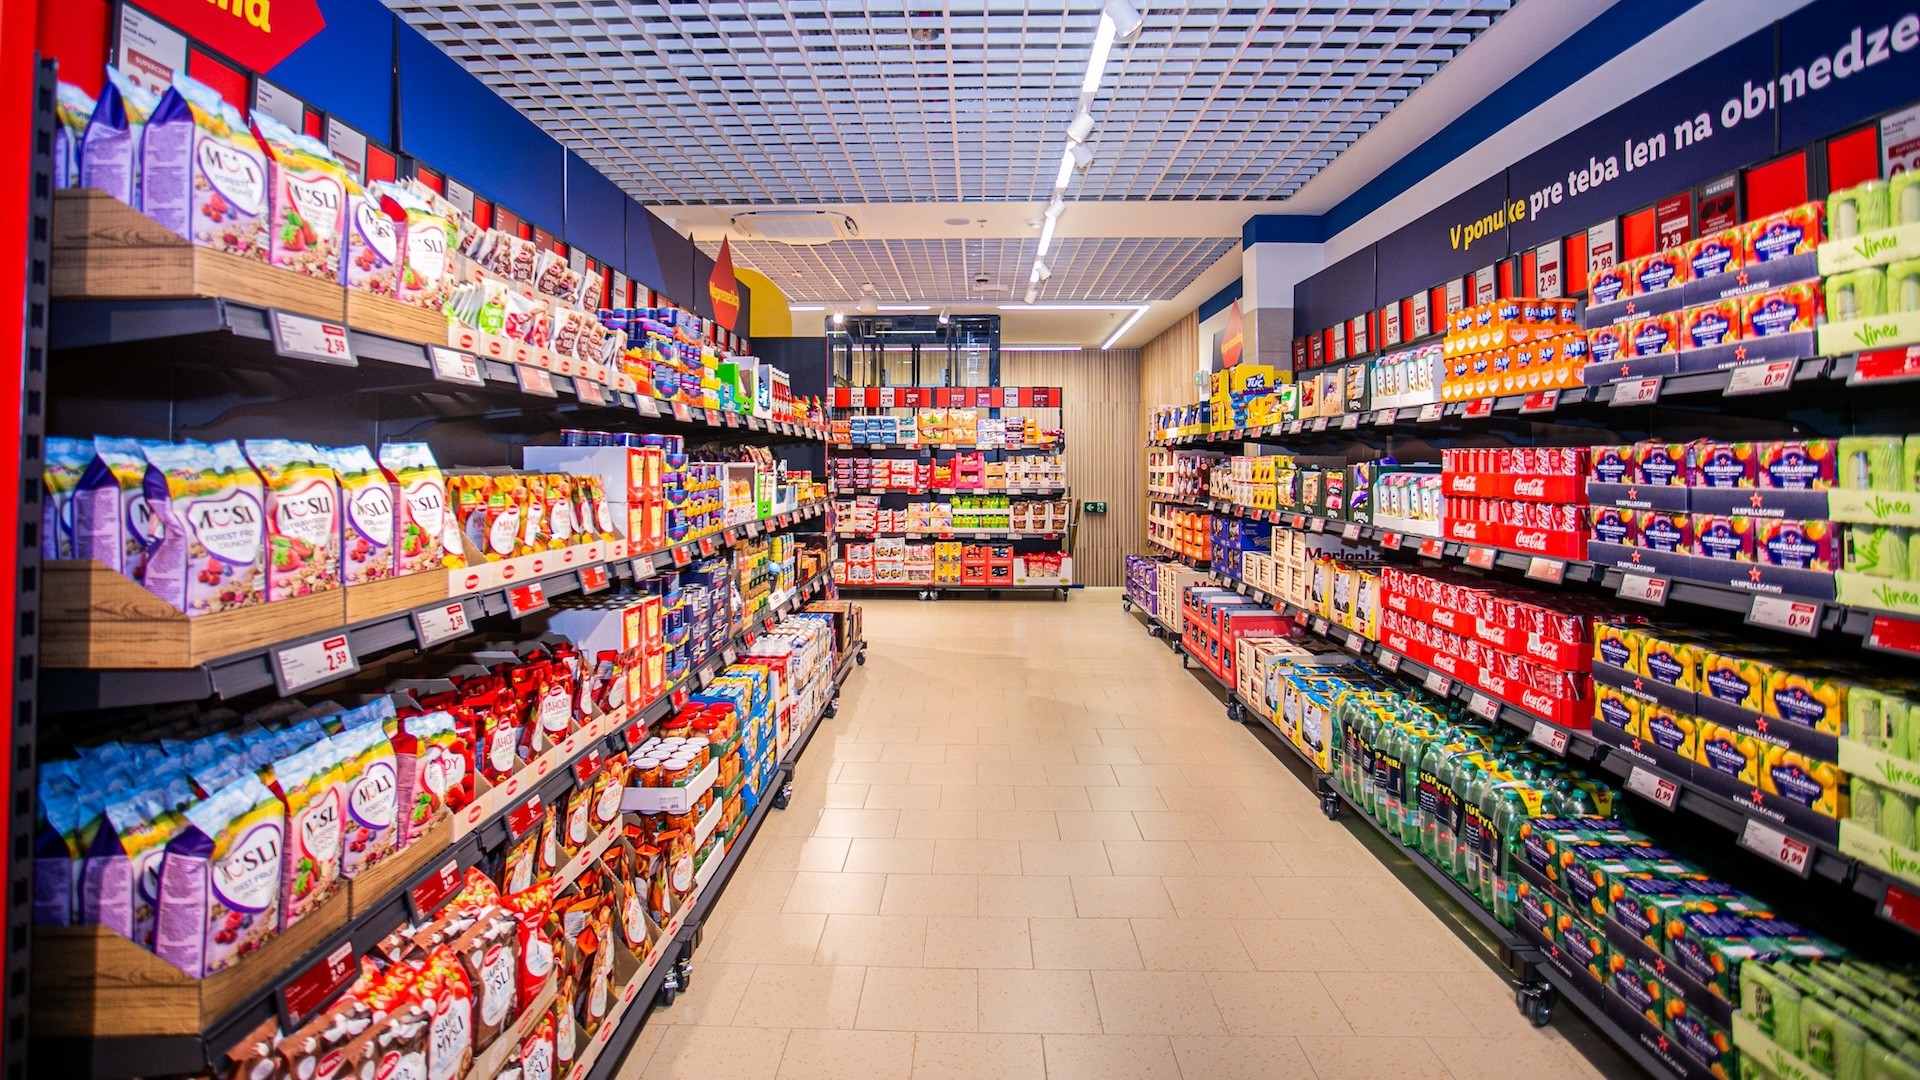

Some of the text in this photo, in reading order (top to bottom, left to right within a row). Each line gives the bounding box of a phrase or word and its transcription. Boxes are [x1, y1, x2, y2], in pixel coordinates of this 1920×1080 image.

[1450, 223, 1461, 250] V
[1463, 199, 1526, 251] ponuke
[1530, 183, 1563, 221] pre
[1568, 154, 1619, 198] teba
[1624, 131, 1666, 173] len
[1674, 112, 1713, 151] na
[1706, 180, 1735, 196] PARKSIDE
[1854, 235, 1898, 260] Vinea
[1540, 273, 1557, 293] 2.99
[1854, 322, 1898, 347] Vinea
[325, 337, 345, 354] 2.59
[1246, 377, 1264, 388] TUC
[1763, 372, 1785, 387] 0.99
[1514, 478, 1545, 497] Coca-Cola
[1732, 507, 1785, 517] SANPELLEGRINO
[1865, 495, 1911, 520] Vinea
[1515, 530, 1548, 551] Coca-Cola
[1645, 587, 1661, 599] 0.99
[1730, 579, 1782, 594] SANPELLEGRINO
[1872, 583, 1920, 608] Vinea
[1788, 613, 1811, 628] 0.99
[326, 650, 347, 672] 2.59
[1522, 689, 1554, 717] Coca-Cola
[1737, 724, 1791, 749] SANPELLEGRINO
[1655, 788, 1671, 801] 0.99
[1732, 795, 1785, 823] SANPELLEGRINO
[1780, 847, 1803, 865] 0.99
